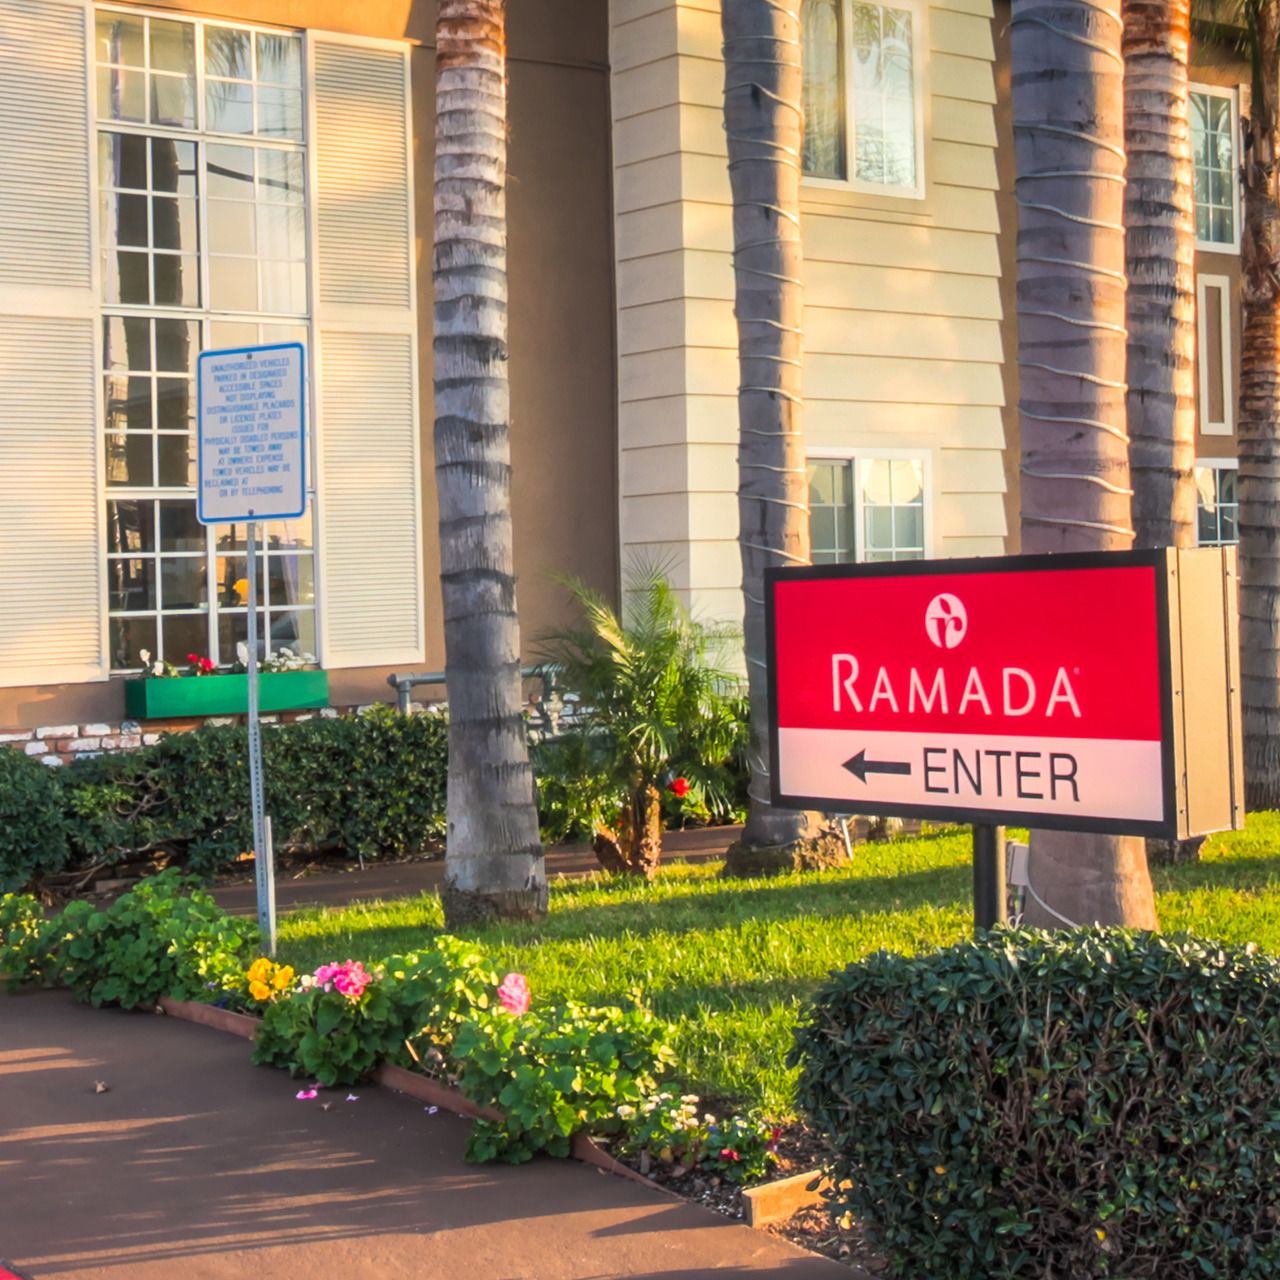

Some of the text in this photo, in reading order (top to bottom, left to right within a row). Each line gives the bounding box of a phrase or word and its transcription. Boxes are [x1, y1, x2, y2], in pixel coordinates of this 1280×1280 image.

[260, 357, 289, 368] VEHICLES
[214, 373, 237, 382] PARKED
[249, 368, 287, 380] DESIGNATED
[219, 379, 282, 392] ACCESSIBLE SPACES
[225, 391, 275, 402] NOT DISPLAYING
[262, 399, 295, 409] PLACARDS
[219, 411, 282, 424] OR LICENSE PLATES
[257, 423, 269, 431] FOR
[204, 431, 298, 445] PHYSICALLY DISABLED PERSONS
[233, 446, 240, 454] BE
[244, 444, 265, 453] TOWED
[268, 443, 282, 451] AWAY
[218, 457, 224, 465] AT
[256, 454, 283, 463] EXPENSE
[212, 463, 290, 476] TOWED VEHICLES MAY BE
[204, 477, 248, 488] RECLAIMED AT
[219, 485, 283, 497] OR BY TELEPHONING
[831, 653, 1082, 718] RAMADA
[923, 747, 1080, 802] ENTER
